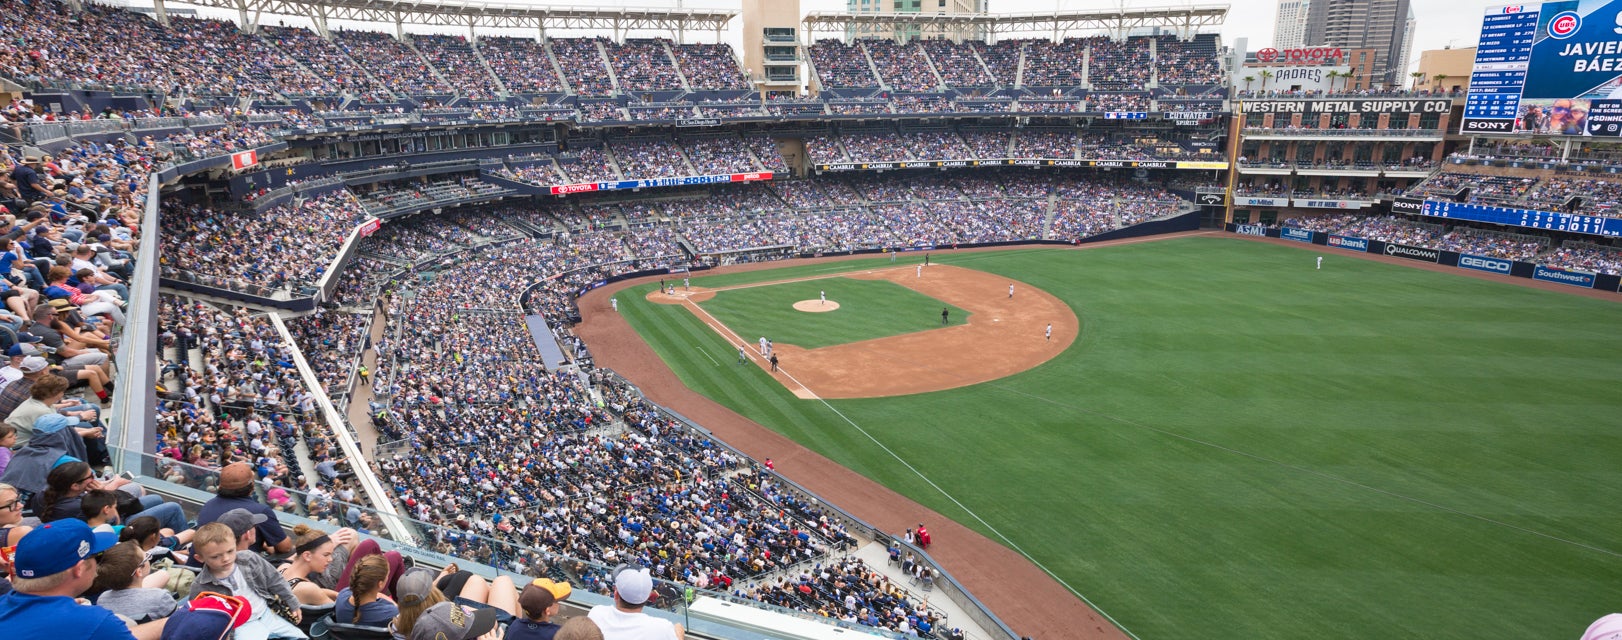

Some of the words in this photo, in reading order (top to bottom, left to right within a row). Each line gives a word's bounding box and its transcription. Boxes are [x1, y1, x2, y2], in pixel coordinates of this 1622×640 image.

[1554, 16, 1576, 34] CUBS
[1284, 48, 1342, 59] TOYOTA
[1276, 69, 1321, 83] PADRES
[1242, 101, 1305, 112] WESTERN
[1311, 101, 1357, 112] METAL
[1362, 101, 1419, 112] SUPPLY
[1424, 101, 1449, 112] CO.
[1236, 225, 1266, 236] ASML
[1583, 224, 1588, 232] 1
[1594, 224, 1600, 233] 1
[1461, 257, 1509, 271] GEICO
[1538, 269, 1584, 282] Southwest
